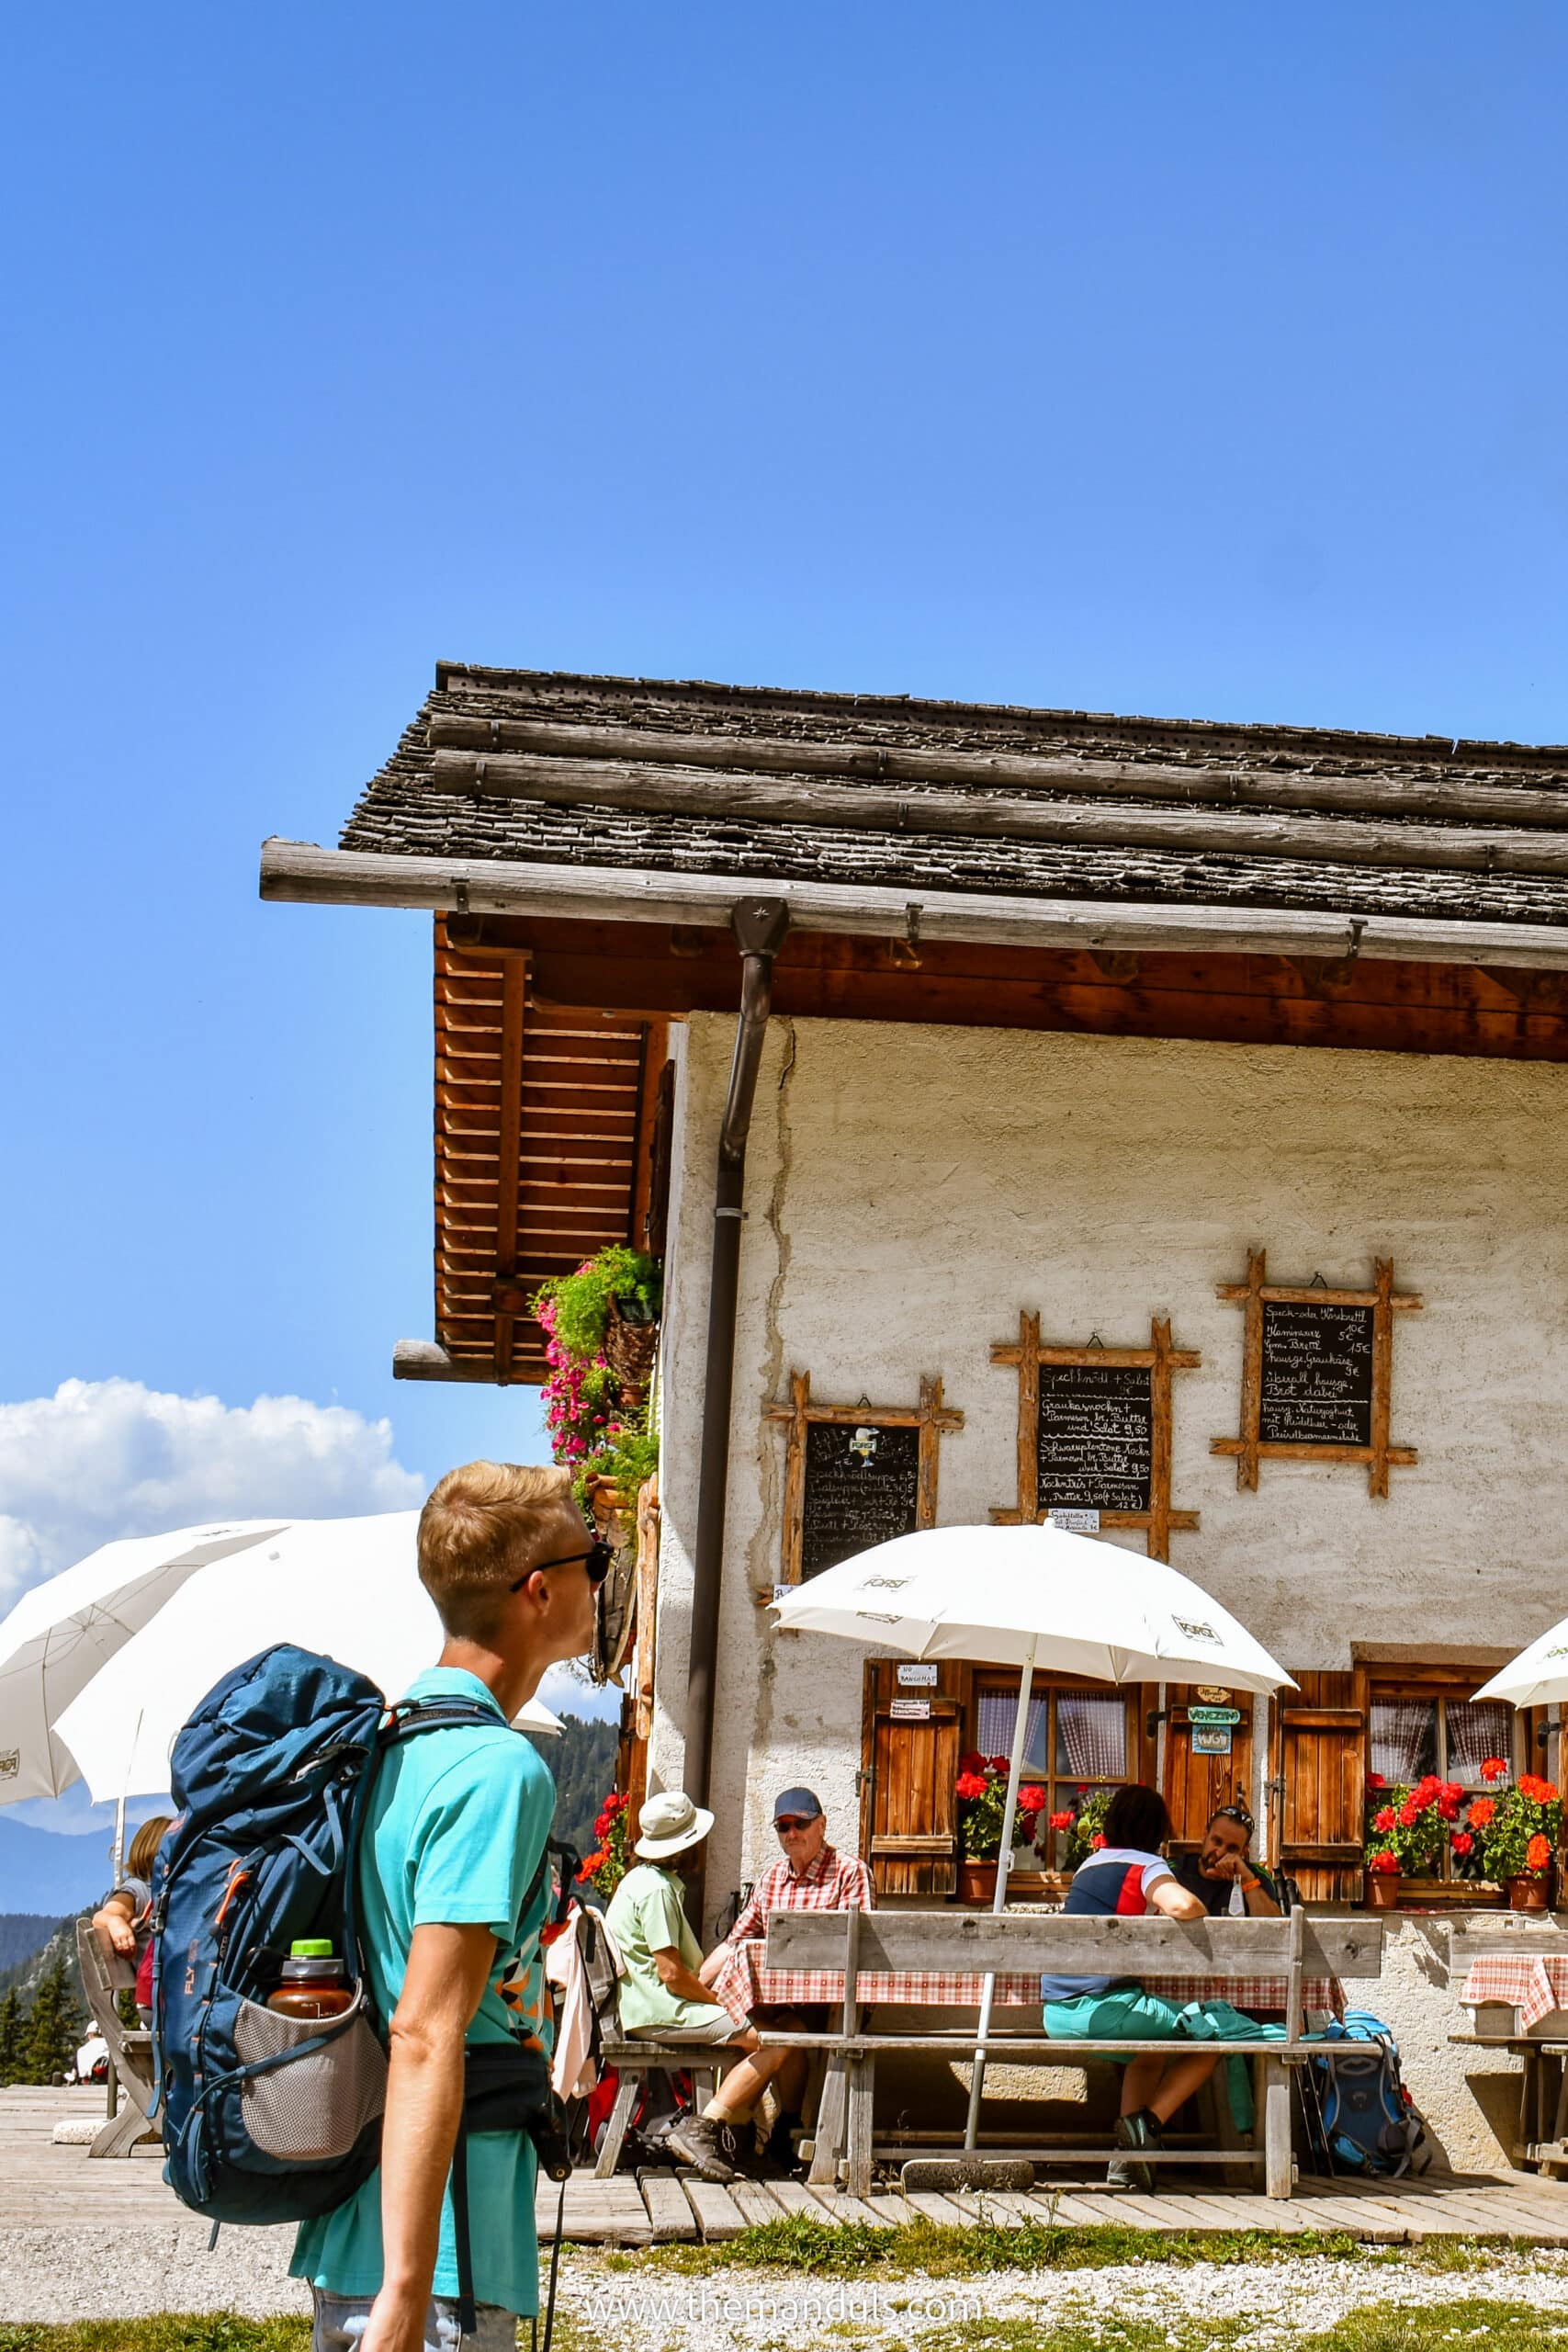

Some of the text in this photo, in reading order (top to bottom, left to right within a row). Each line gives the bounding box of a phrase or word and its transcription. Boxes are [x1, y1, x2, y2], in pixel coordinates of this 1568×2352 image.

[1338, 1331, 1355, 1340] 5€
[1347, 1342, 1371, 1353] 15€
[1264, 1371, 1309, 1384] überall
[1345, 1366, 1359, 1377] 9€
[1265, 1383, 1337, 1398] Brot dabei
[1111, 1413, 1148, 1425] Butter
[1066, 1421, 1147, 1438] und Salat 9,50
[1103, 1462, 1130, 1474] Salat
